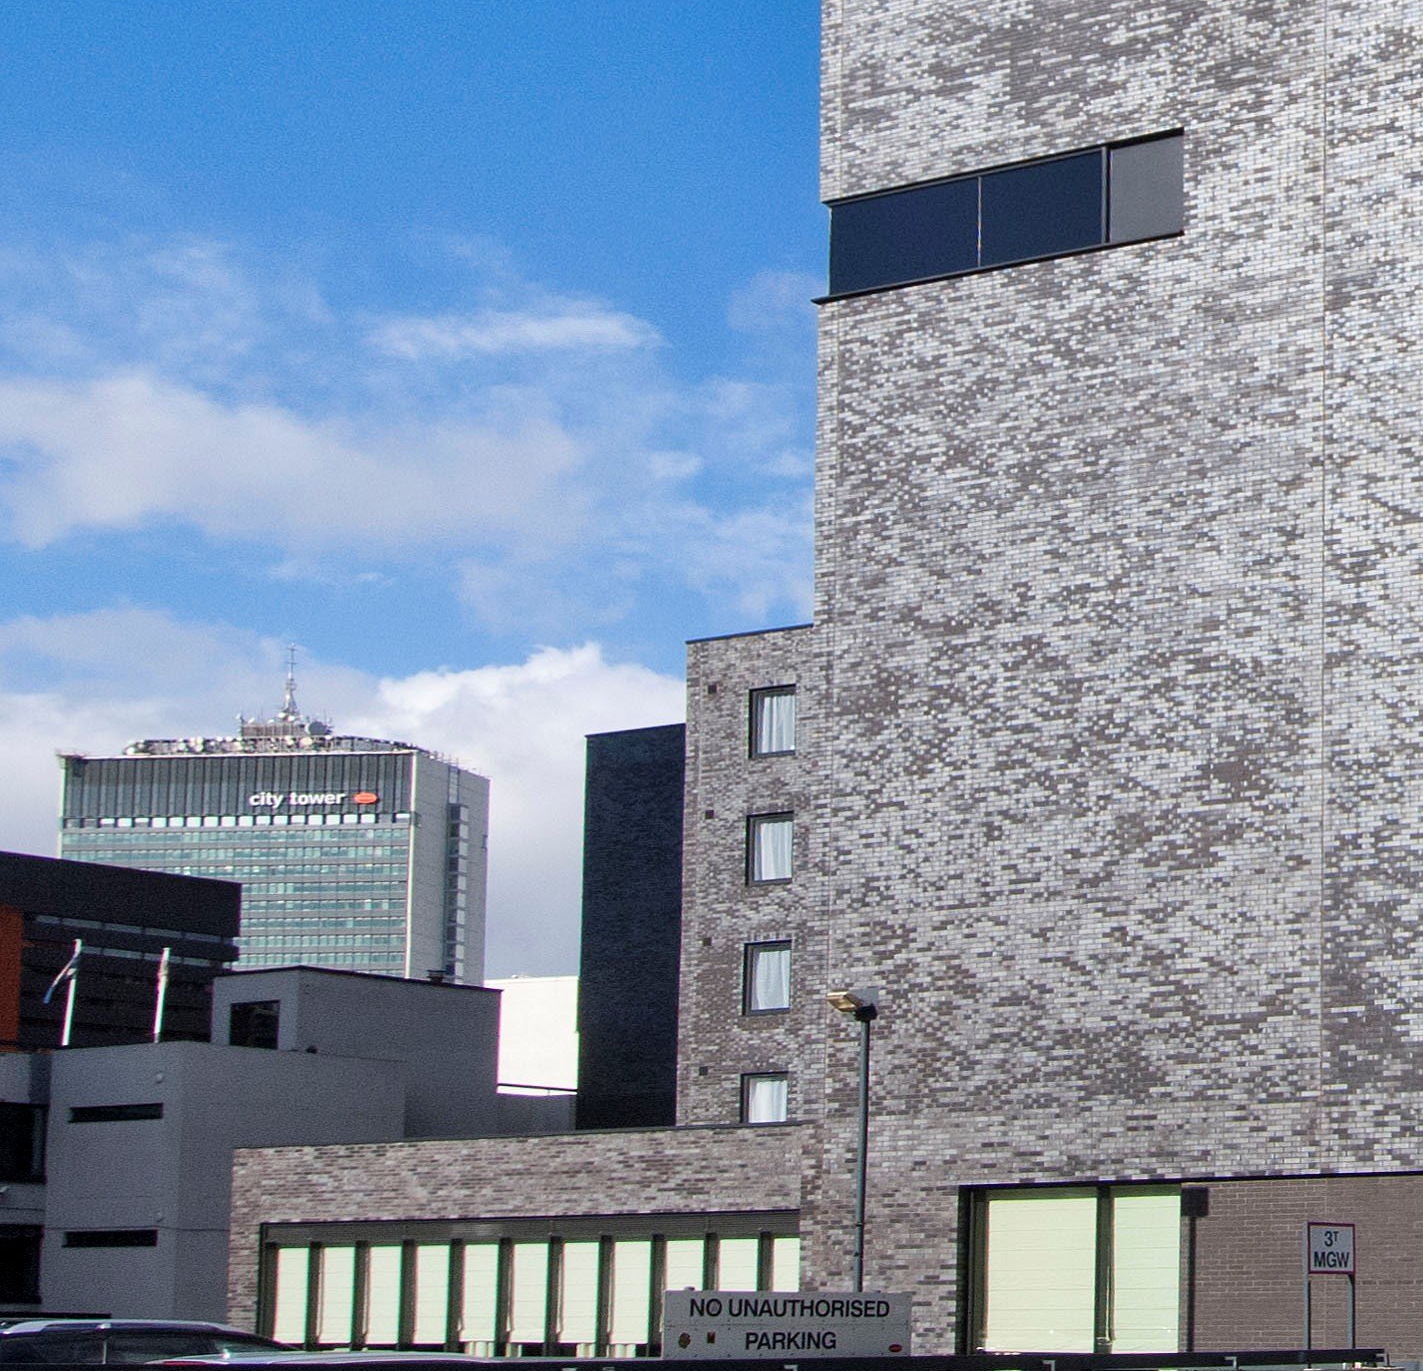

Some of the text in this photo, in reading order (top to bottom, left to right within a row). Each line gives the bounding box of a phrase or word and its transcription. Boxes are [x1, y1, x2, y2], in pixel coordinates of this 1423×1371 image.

[249, 791, 346, 808] city tower
[1314, 1251, 1350, 1268] MGW
[690, 1298, 890, 1318] NO UNAUTHORISED
[745, 1331, 837, 1350] PARKING
